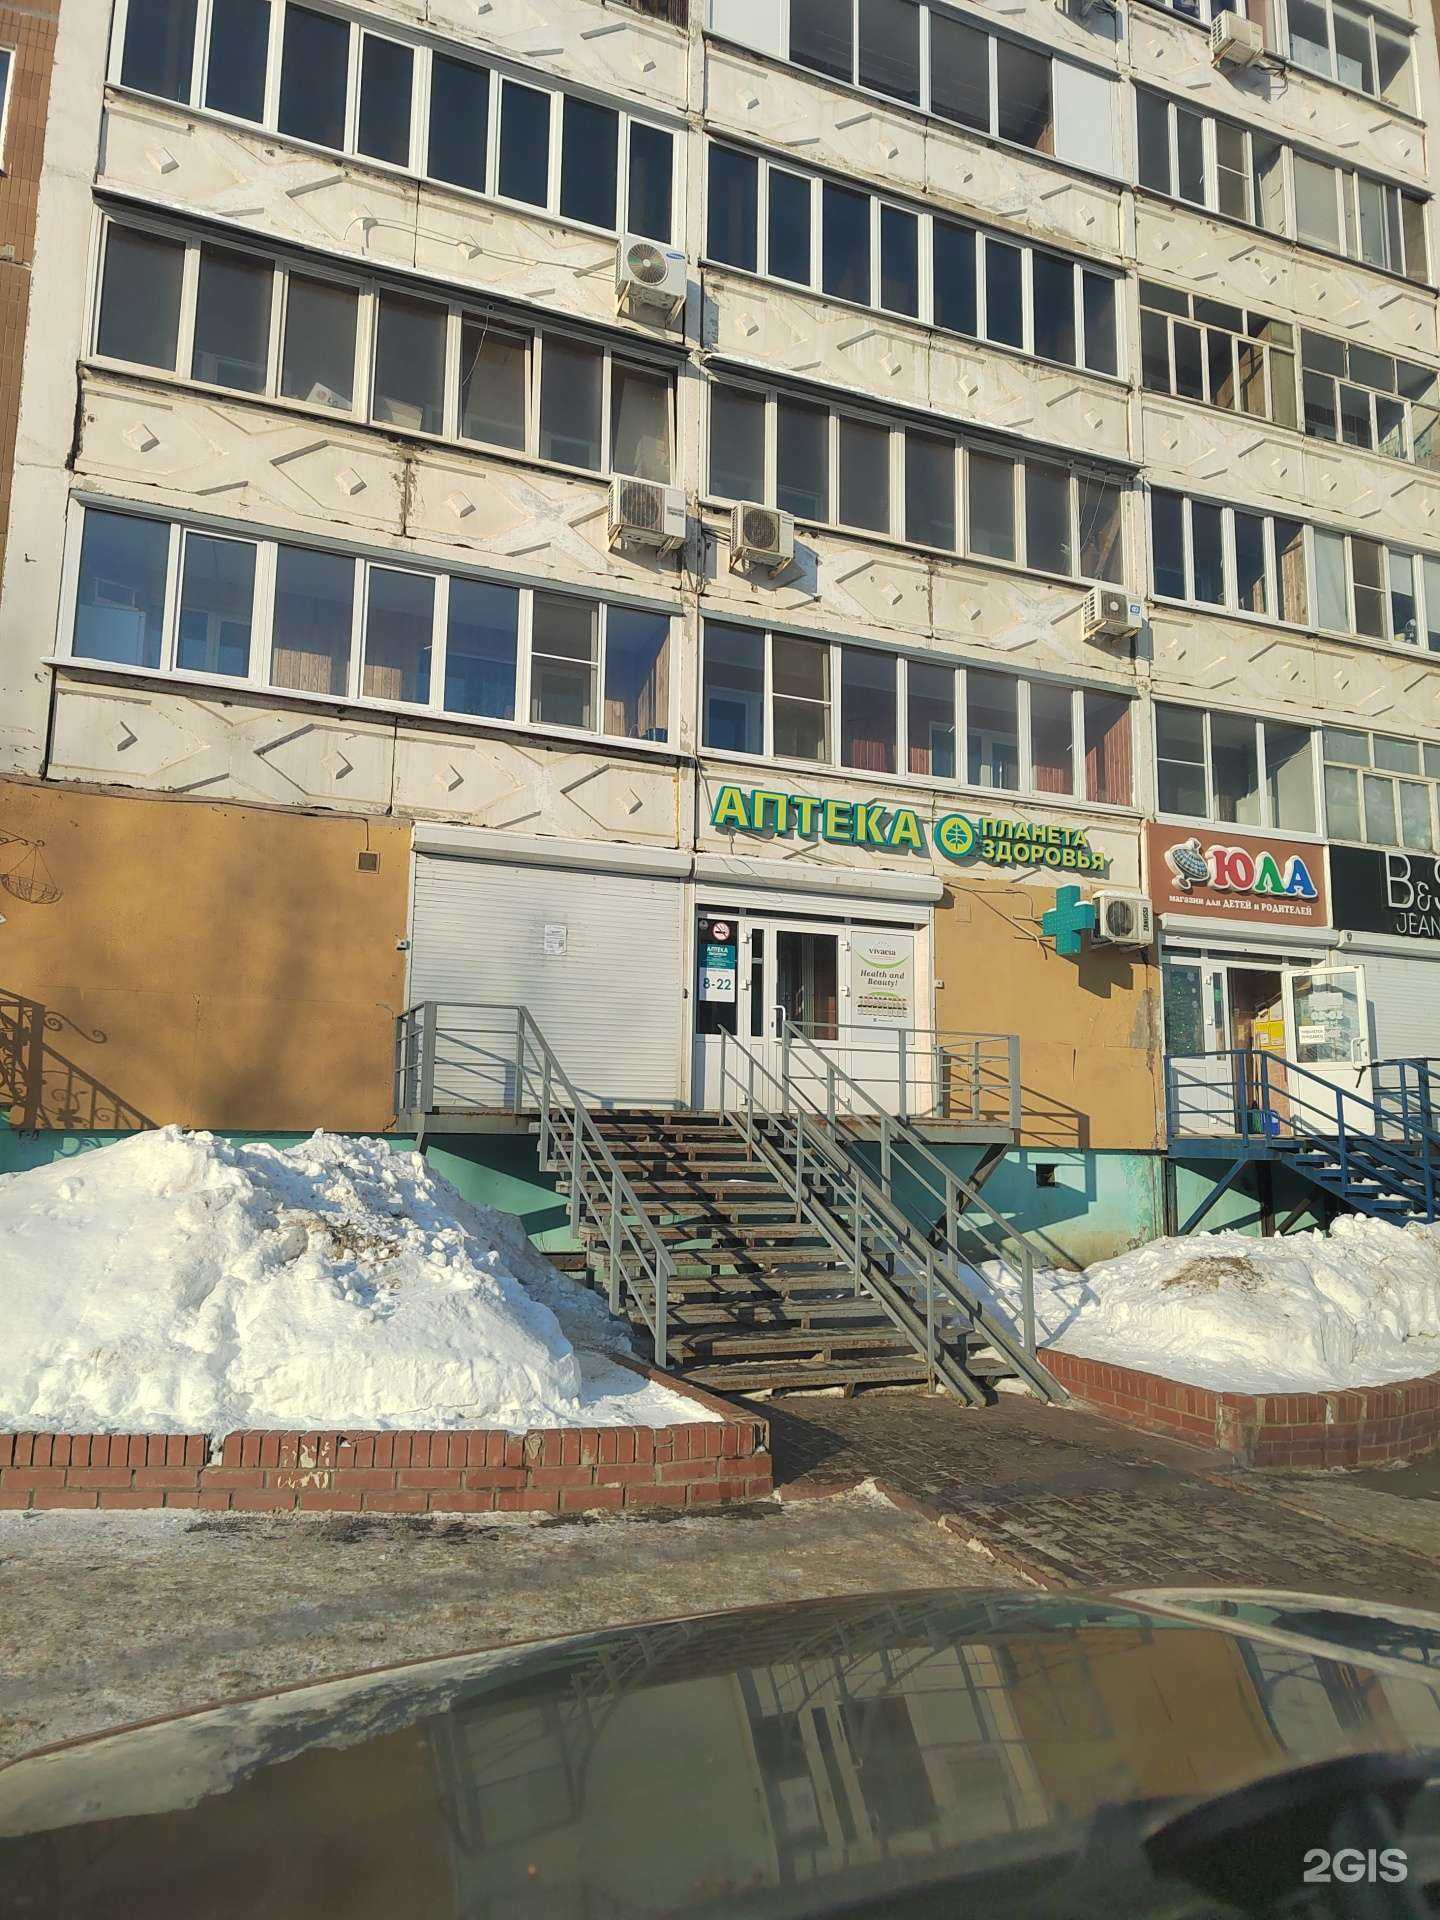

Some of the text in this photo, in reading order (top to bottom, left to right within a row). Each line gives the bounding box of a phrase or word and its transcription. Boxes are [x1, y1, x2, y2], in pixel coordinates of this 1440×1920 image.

[710, 785, 924, 851] АПТЕКА
[979, 816, 1088, 848] ПЛАНЕТА
[980, 838, 1106, 871] ЗДОРОВЬЯ
[1206, 845, 1318, 898] ЮЛА
[1222, 898, 1252, 910] ДЕТЕЙ
[1261, 902, 1313, 916] РОДИТЕЛЕЙ
[703, 977, 732, 991] 8-22
[860, 969, 905, 979] Health and
